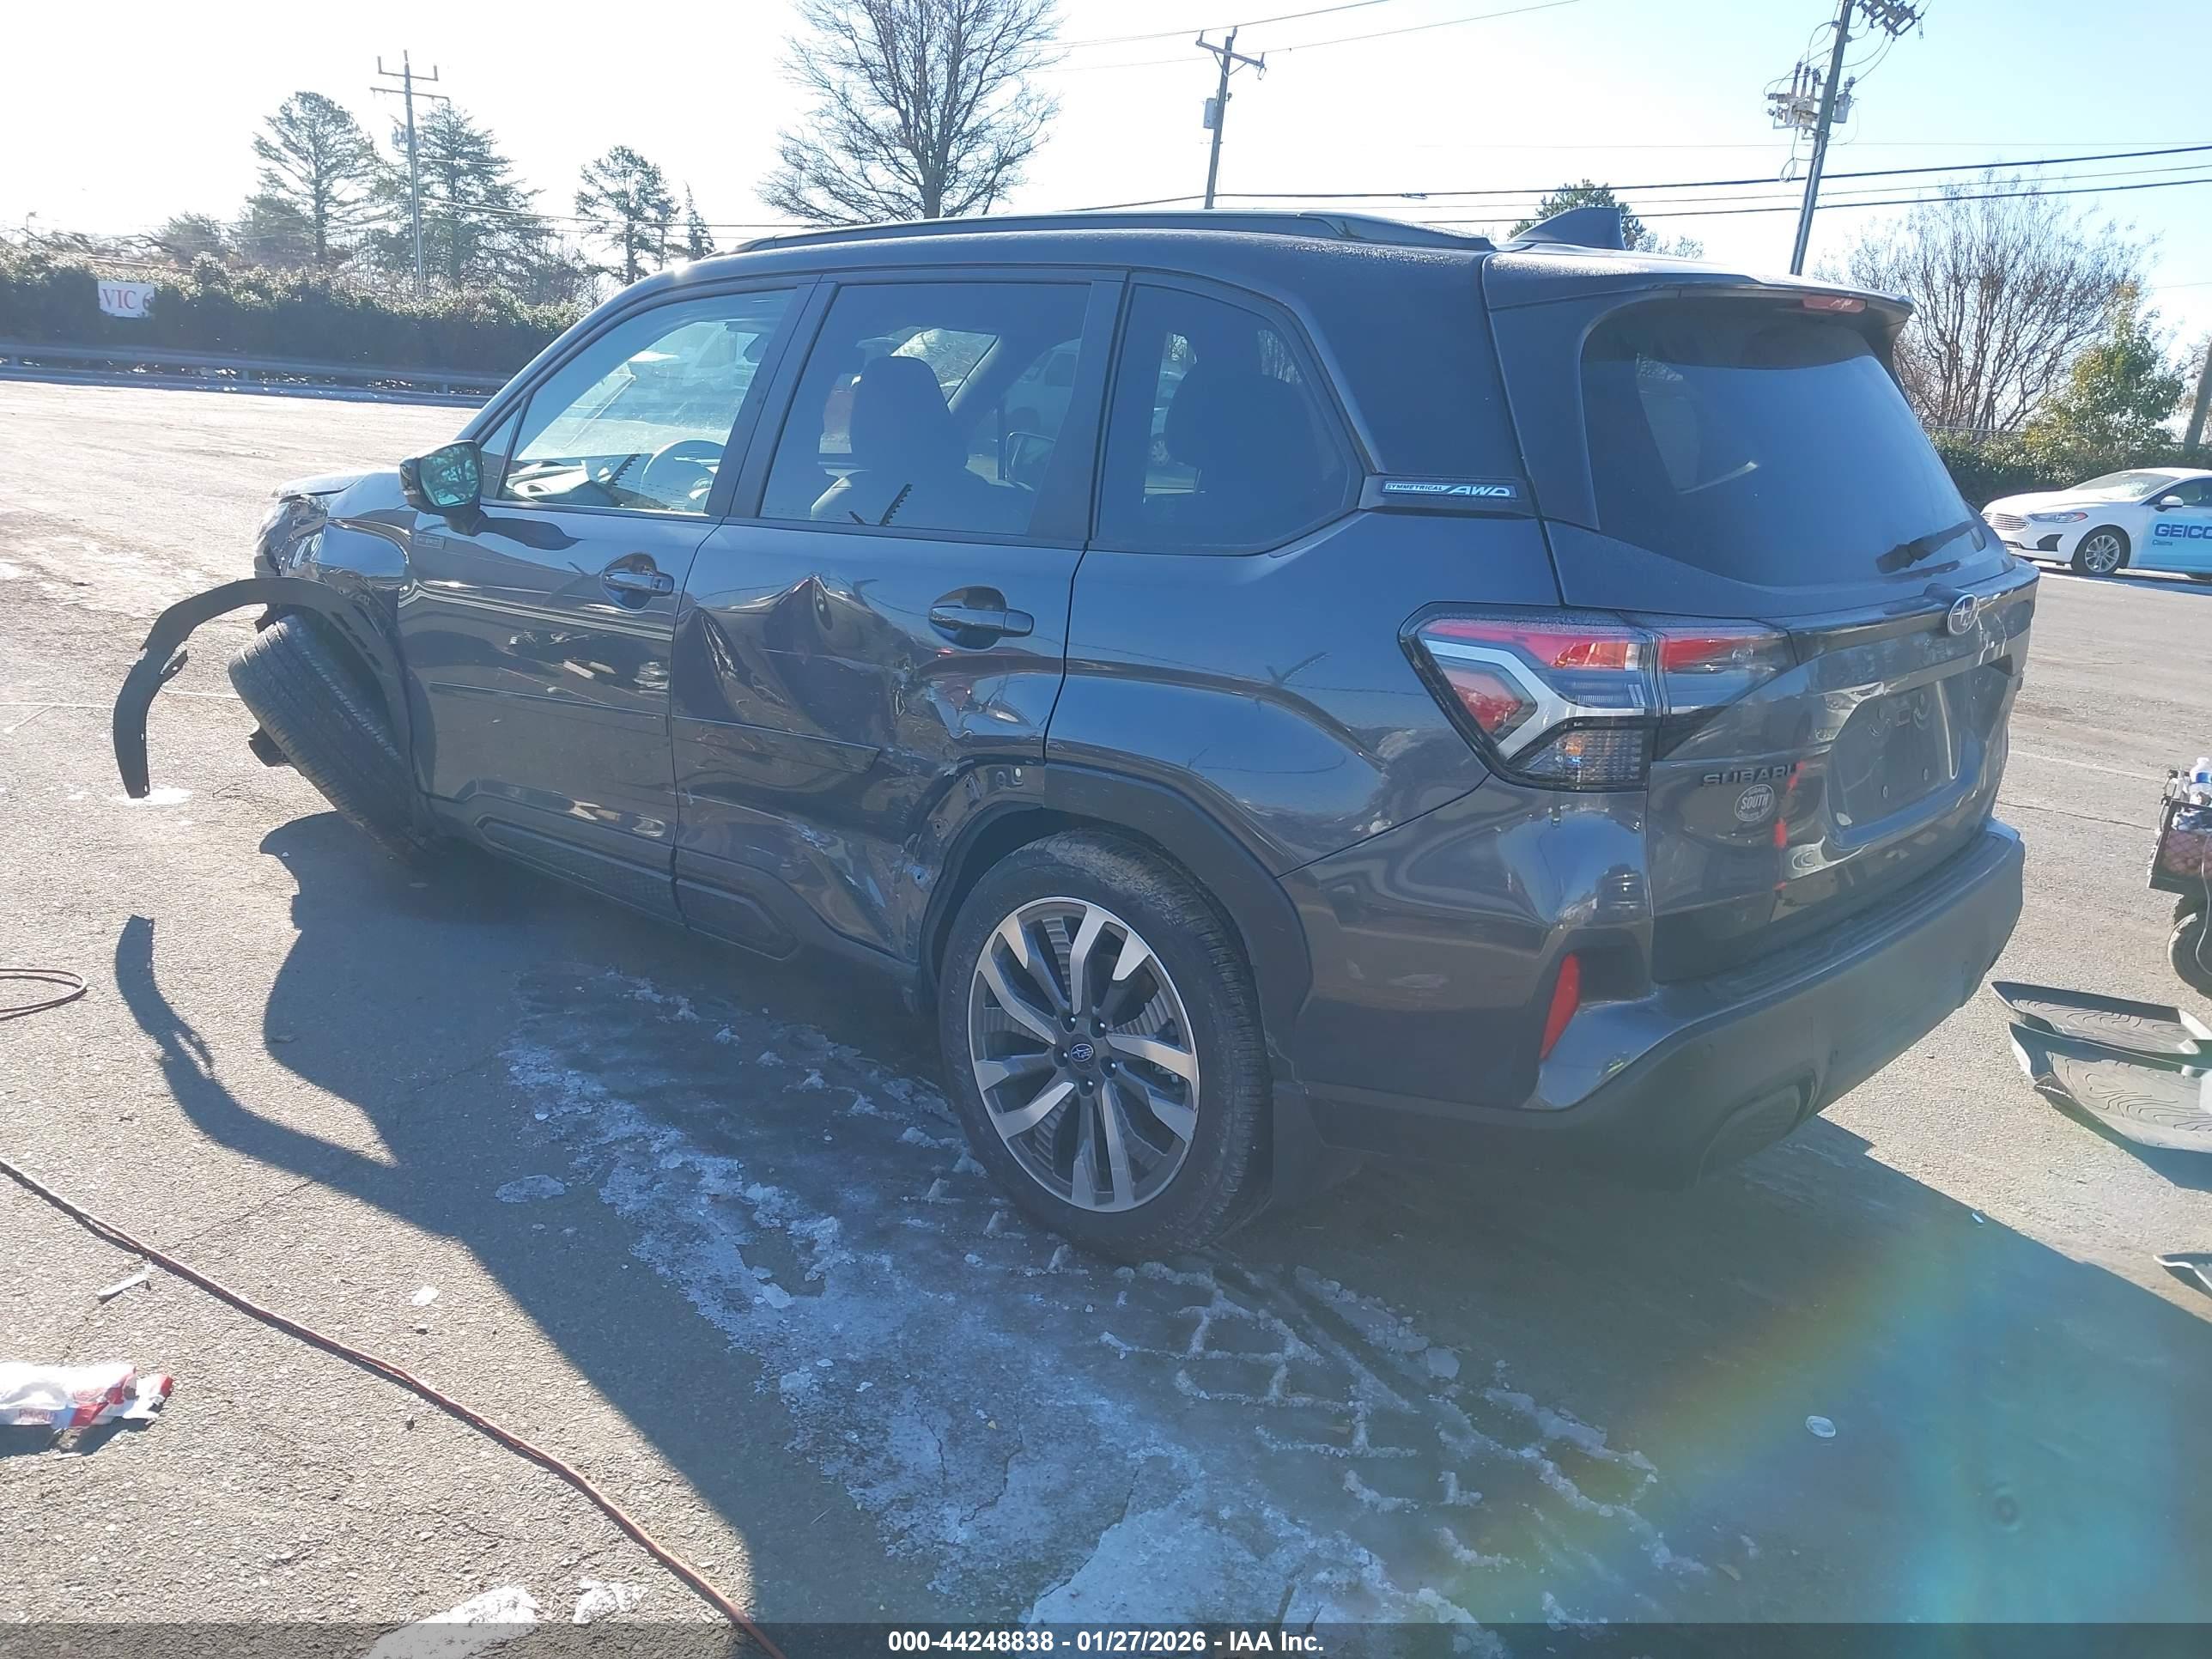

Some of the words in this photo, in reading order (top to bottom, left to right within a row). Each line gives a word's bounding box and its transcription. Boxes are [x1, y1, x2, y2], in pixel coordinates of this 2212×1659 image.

[102, 289, 137, 310] VIC
[1386, 483, 1444, 492] SYMMETRICAL
[1448, 485, 1510, 497] AWD
[1741, 793, 1770, 810] SOUTH
